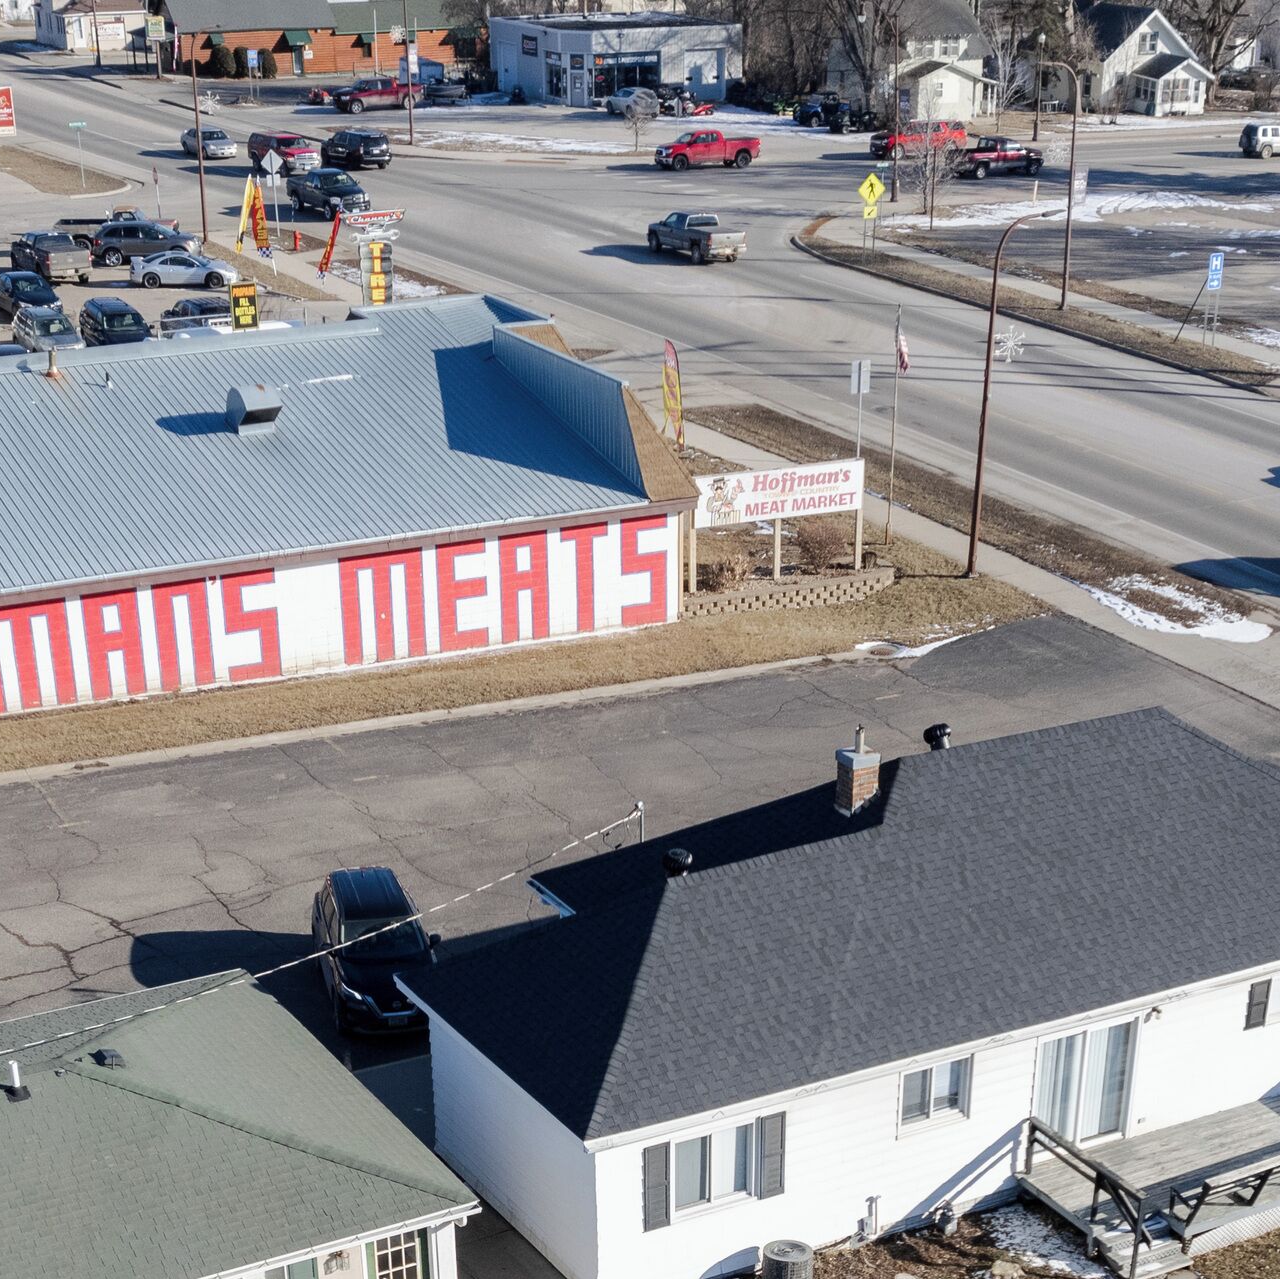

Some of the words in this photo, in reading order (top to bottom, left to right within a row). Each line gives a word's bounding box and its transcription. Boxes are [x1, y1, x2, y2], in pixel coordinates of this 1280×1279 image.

[1212, 256, 1221, 270] H
[235, 306, 255, 316] BOTTLES
[752, 469, 851, 493] Hoffman's
[800, 486, 840, 495] COUNTRY
[745, 500, 788, 517] MEAT
[791, 492, 857, 511] MARKET
[338, 513, 669, 666] MEATS
